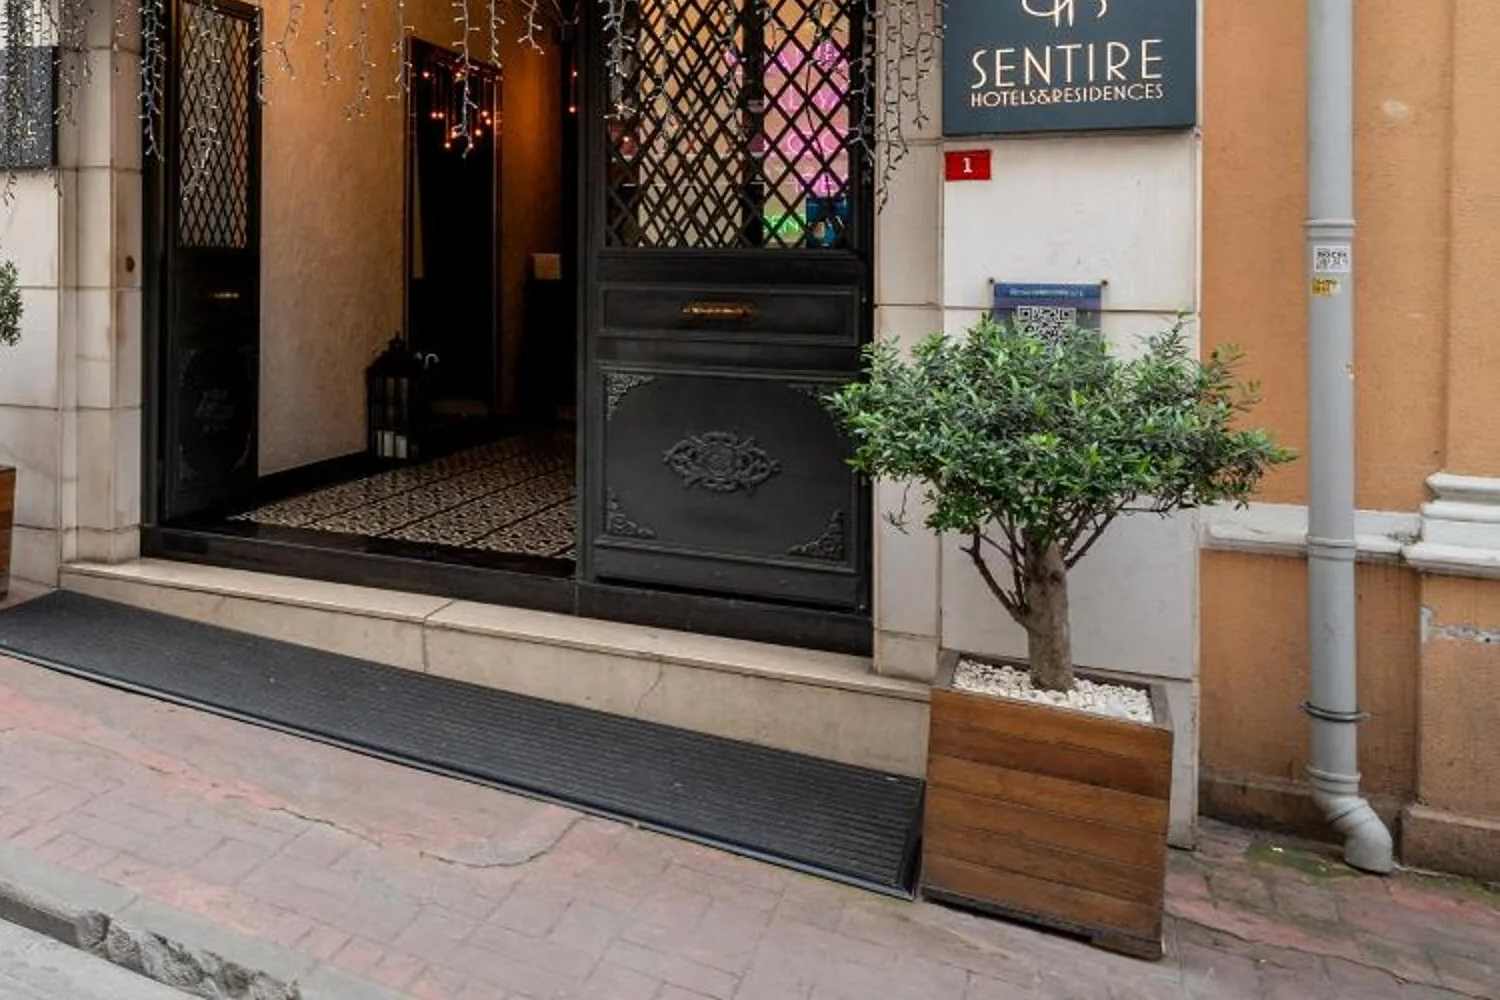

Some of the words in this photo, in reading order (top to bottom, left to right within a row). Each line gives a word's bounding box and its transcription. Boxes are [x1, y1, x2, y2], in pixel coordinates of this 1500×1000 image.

[971, 38, 1164, 90] SENTIRE
[971, 82, 1164, 108] HOTELS&RESIDENCES
[963, 157, 974, 174] 1
